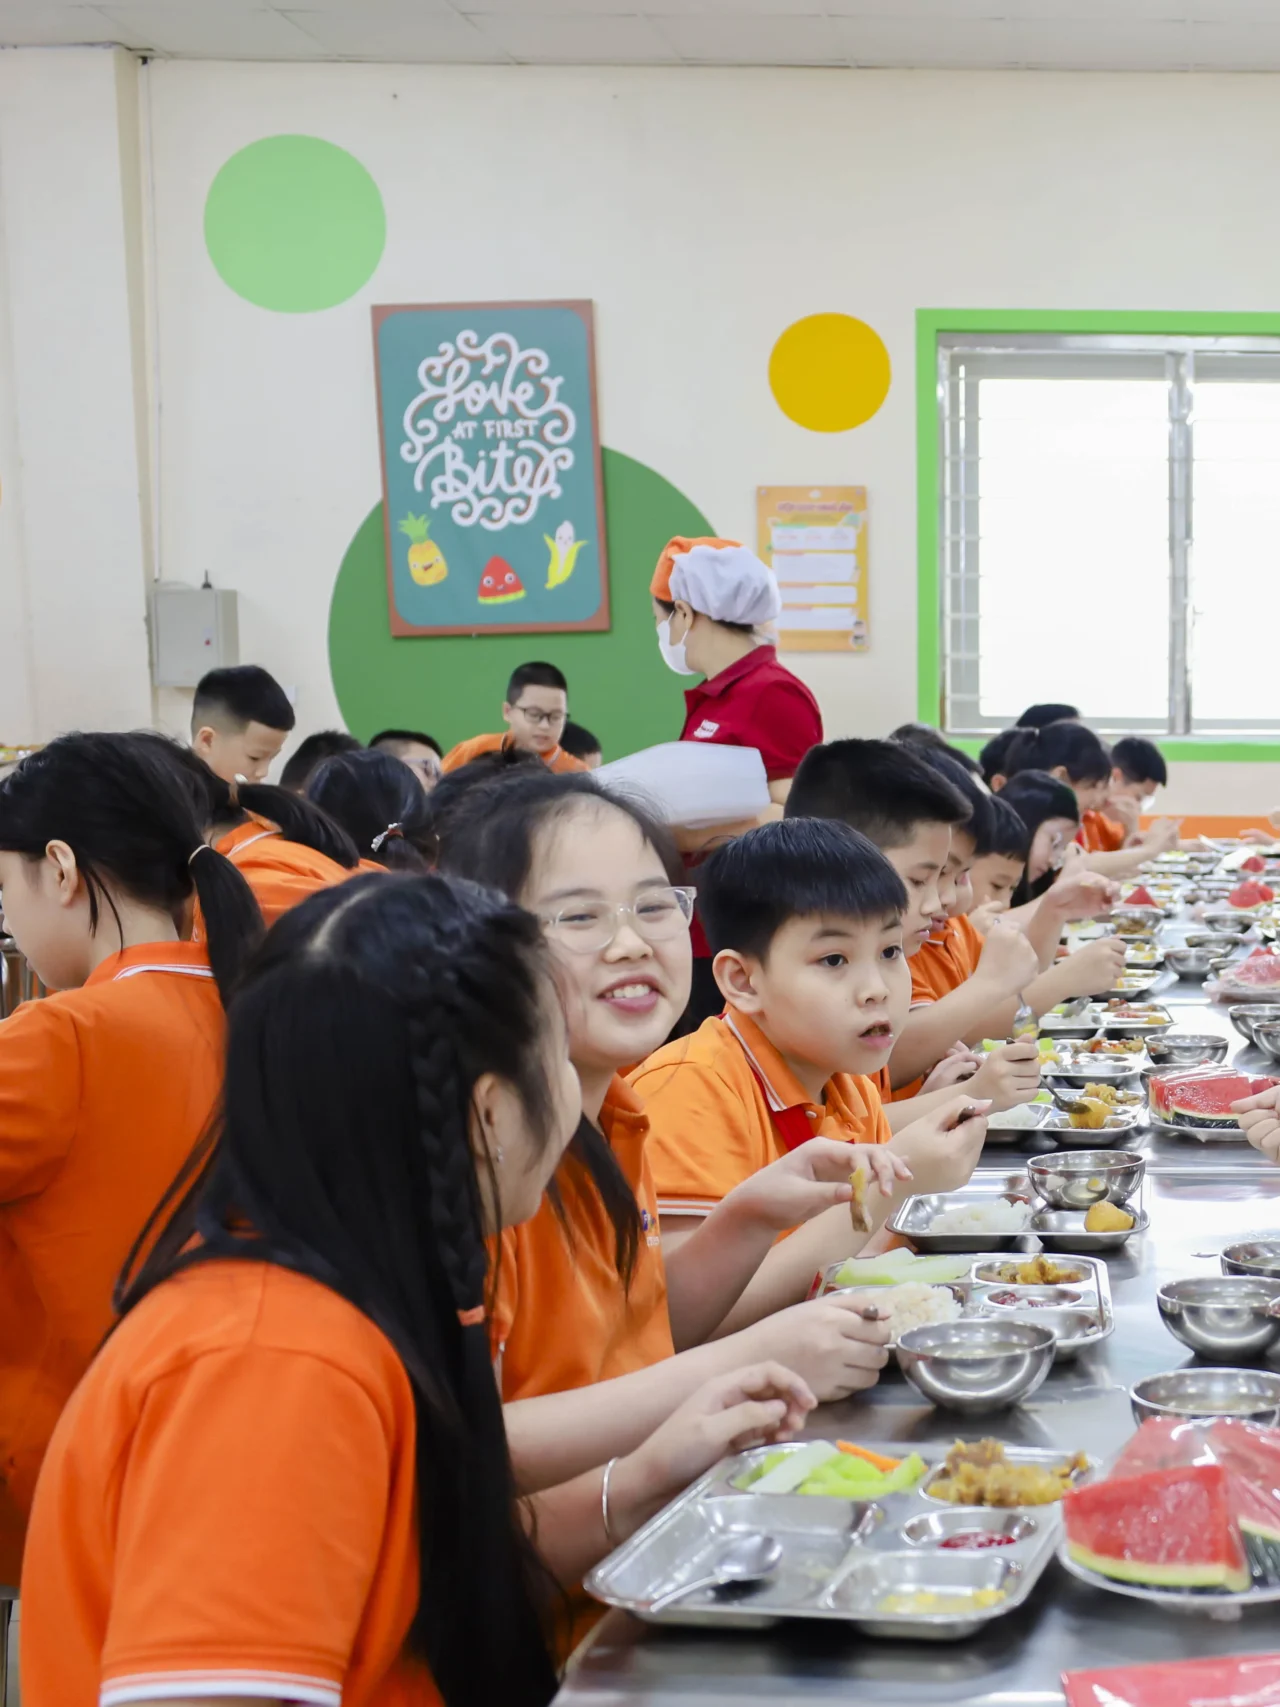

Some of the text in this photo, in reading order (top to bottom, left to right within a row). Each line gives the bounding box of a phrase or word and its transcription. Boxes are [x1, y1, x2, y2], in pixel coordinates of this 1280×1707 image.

[418, 338, 566, 422] Love
[452, 419, 539, 439] AT FIRST
[414, 437, 562, 506] Bite
